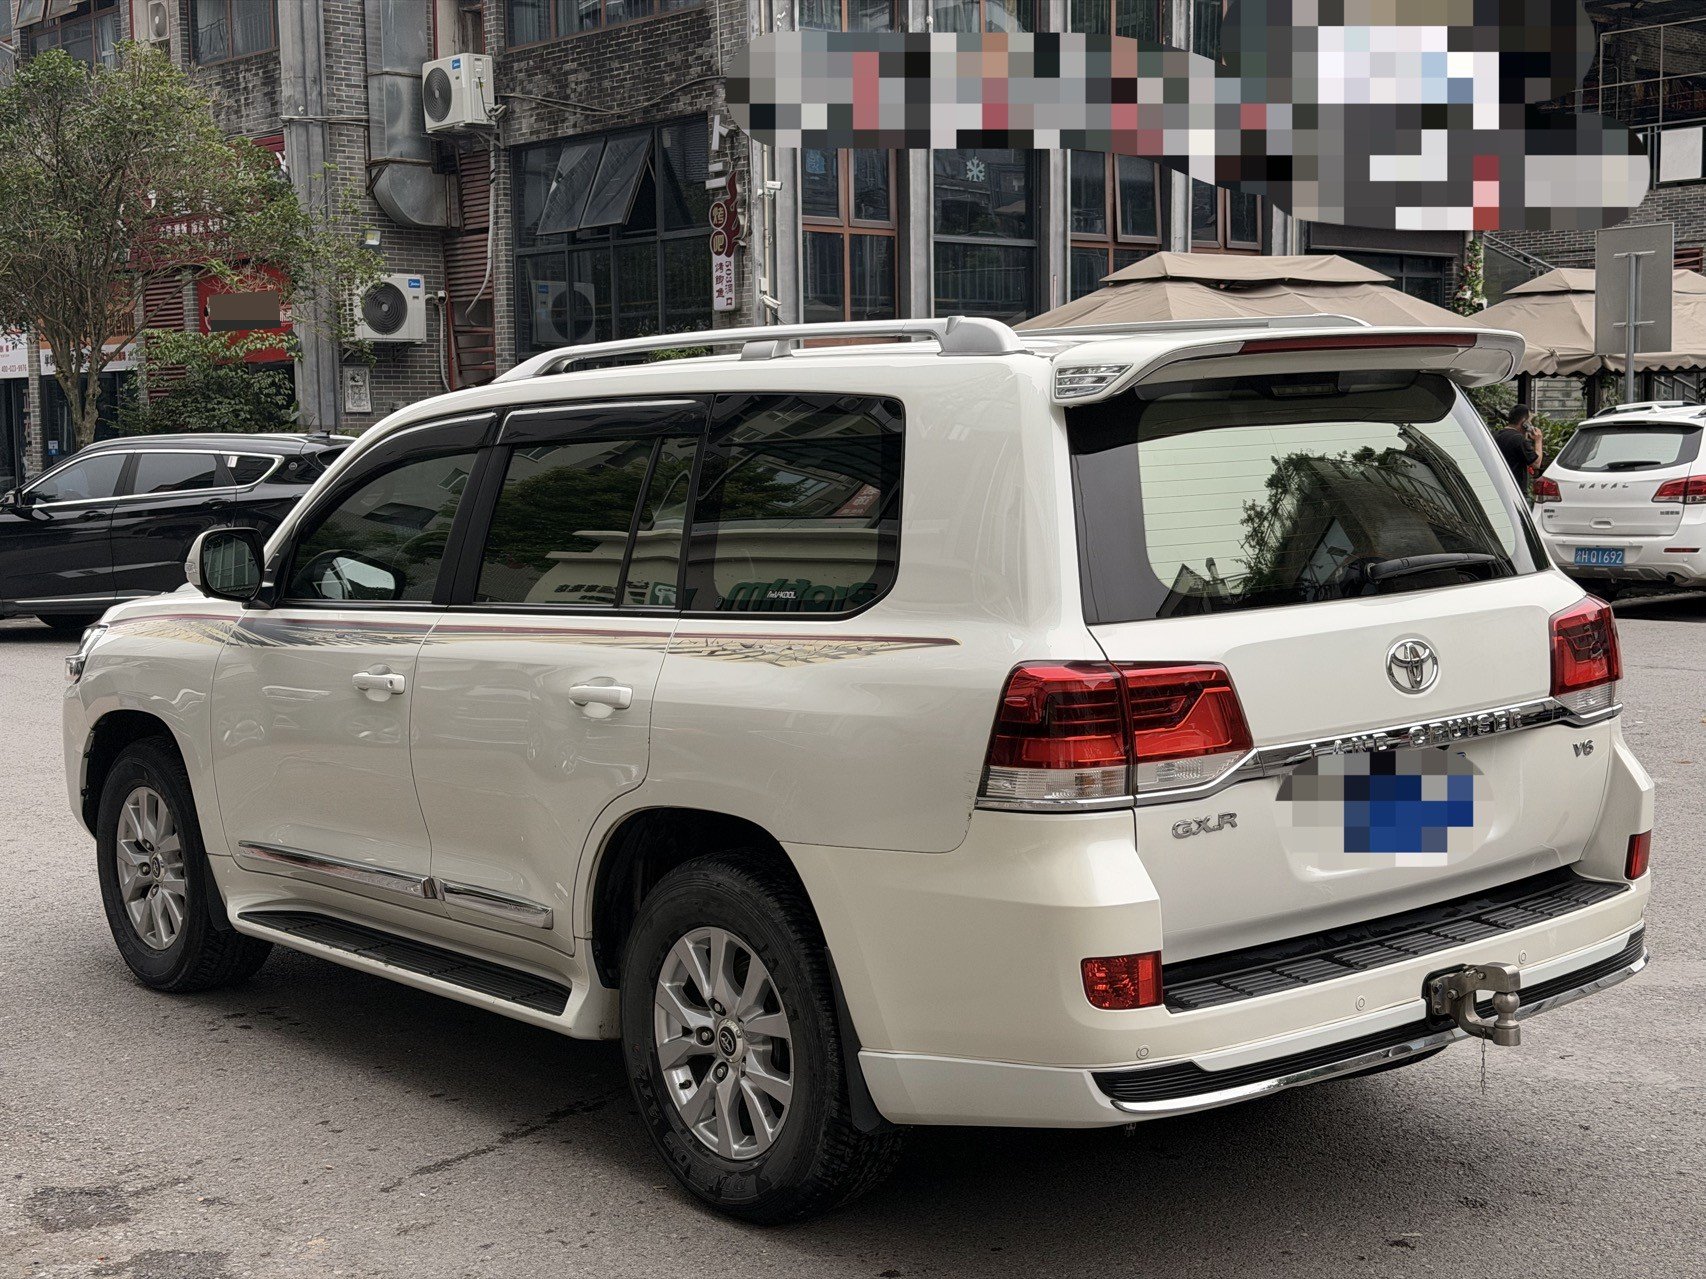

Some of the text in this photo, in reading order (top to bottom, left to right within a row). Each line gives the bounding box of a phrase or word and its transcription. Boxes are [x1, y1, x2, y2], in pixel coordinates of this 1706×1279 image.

[1578, 481, 1630, 490] HAVAL
[1408, 708, 1522, 748] CRUISER
[1572, 739, 1594, 757] V6
